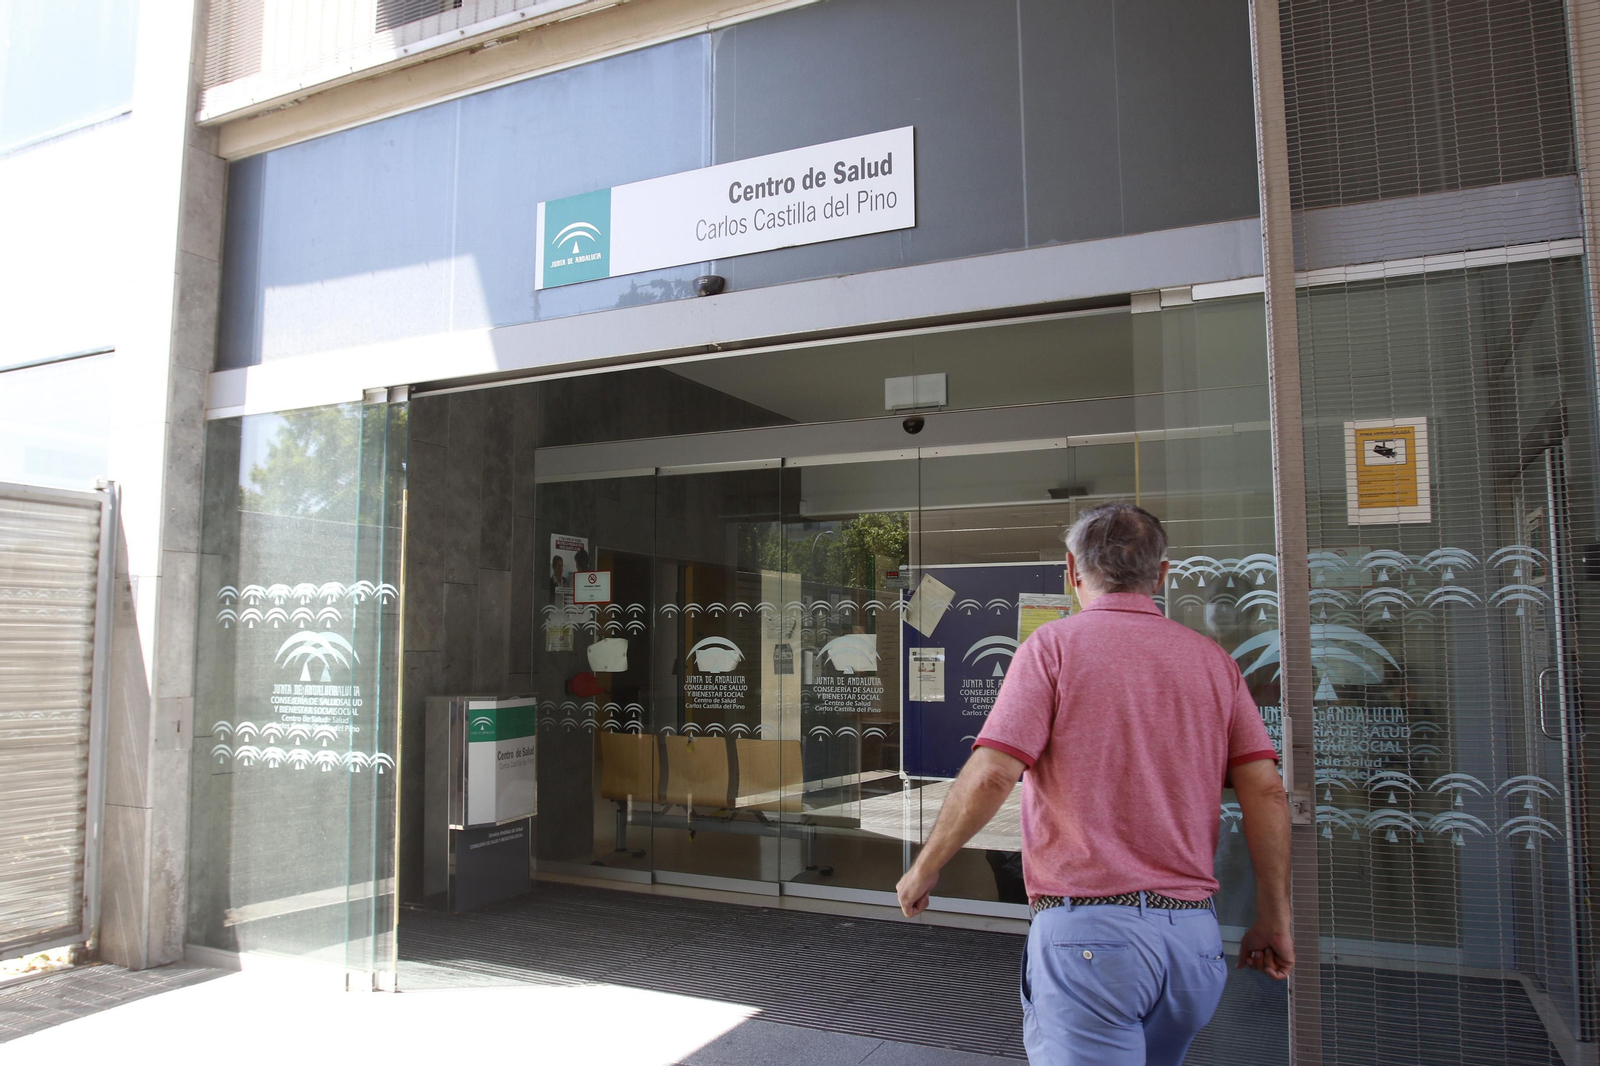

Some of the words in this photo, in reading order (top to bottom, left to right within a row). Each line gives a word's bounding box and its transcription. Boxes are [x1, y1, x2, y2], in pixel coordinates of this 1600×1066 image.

[728, 176, 796, 204] Centro
[802, 167, 826, 190] de
[833, 152, 893, 185] Salud
[696, 215, 748, 242] Carlos
[754, 200, 816, 231] Castilla
[823, 193, 849, 219] del
[858, 190, 898, 214] Pino
[550, 259, 566, 268] JUNTA
[685, 676, 703, 684] JUNTA
[705, 676, 712, 684] DE
[715, 676, 746, 684] ANDALUCIA
[815, 676, 834, 685] JUNTA
[837, 677, 844, 685] DE
[848, 677, 882, 686] ANDALUCIA
[962, 679, 983, 688] JUNTA
[986, 679, 995, 688] DE
[272, 684, 292, 694] JUNTA
[1327, 706, 1405, 723] ANDALUCIA
[1362, 727, 1410, 738] SALUD
[1350, 740, 1404, 753] SOCIAL
[498, 750, 514, 761] Centro
[516, 748, 522, 758] de
[522, 746, 534, 757] Salud
